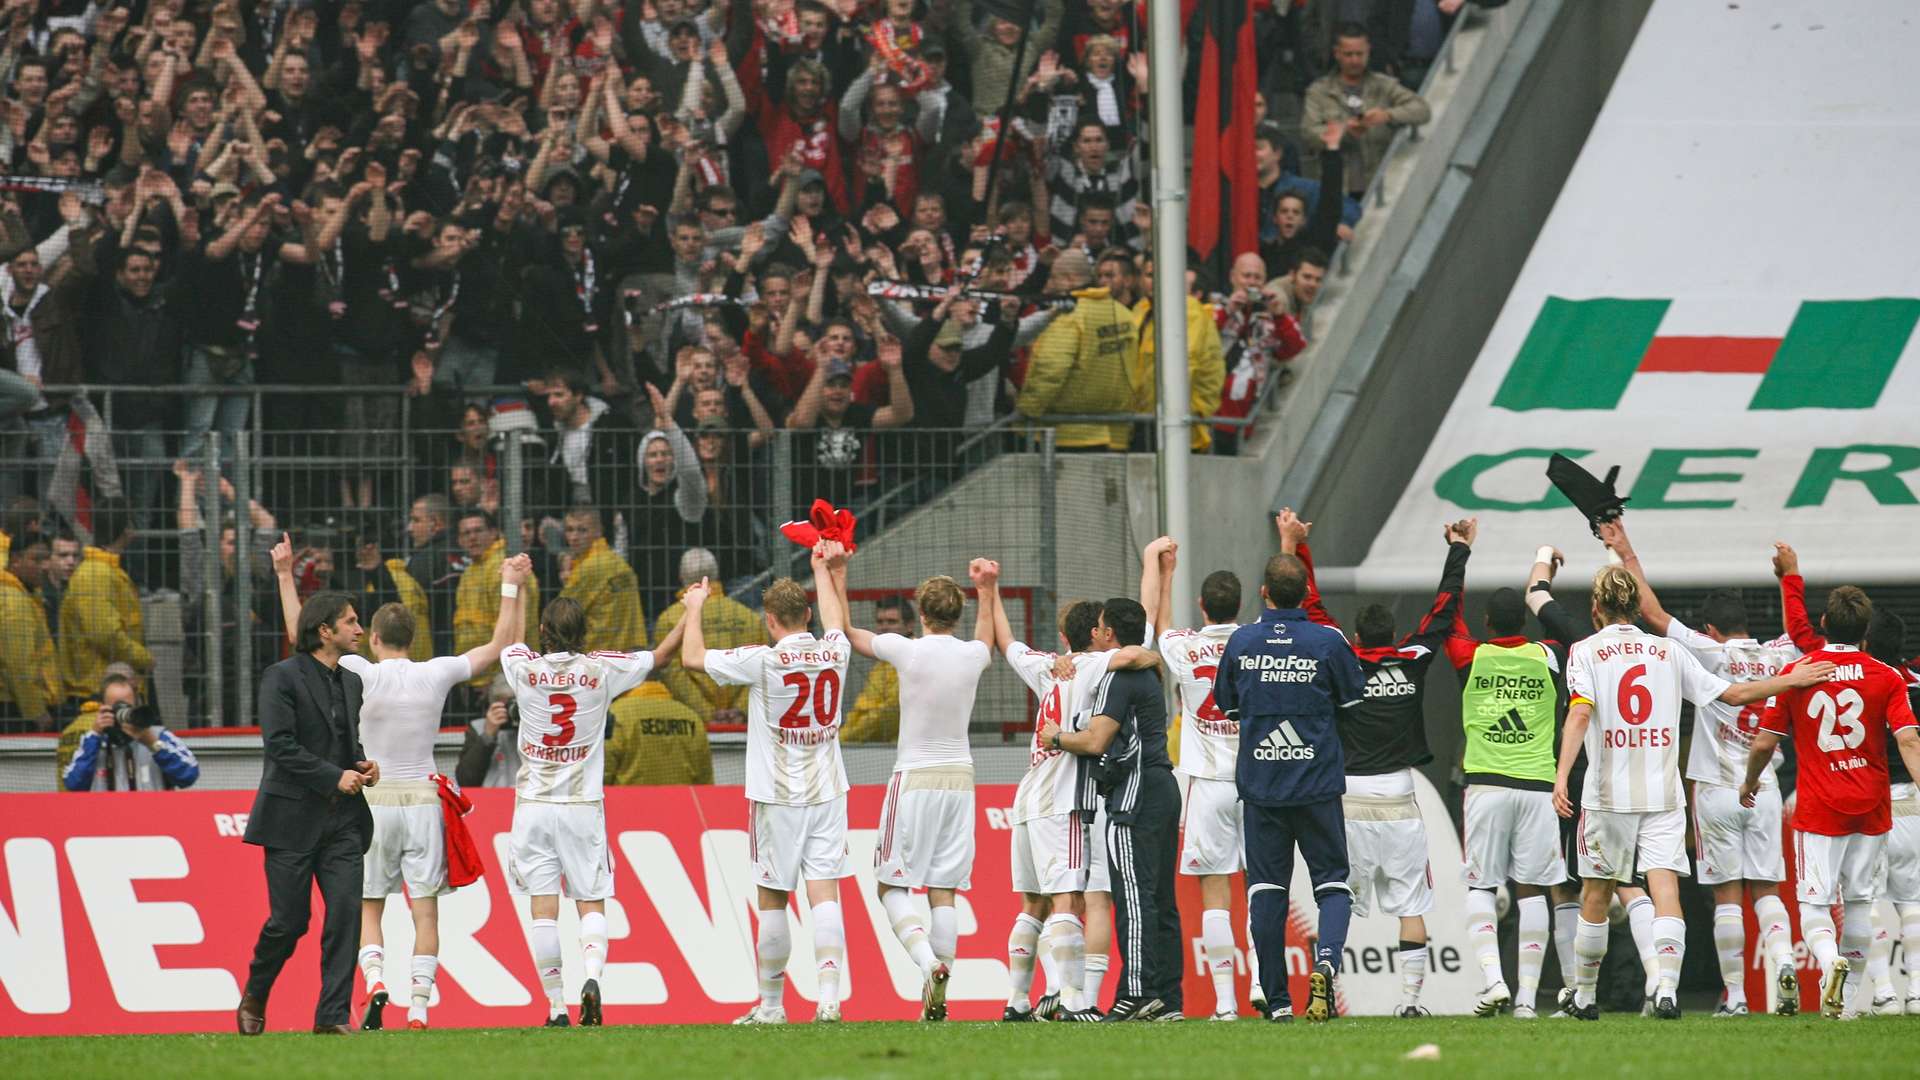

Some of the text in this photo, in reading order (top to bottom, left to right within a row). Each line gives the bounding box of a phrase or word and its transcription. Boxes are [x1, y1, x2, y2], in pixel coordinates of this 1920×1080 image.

[1434, 445, 1920, 512] GER
[1597, 642, 1667, 662] BAYER 04
[1239, 655, 1318, 671] TelDaFax
[1729, 662, 1766, 676] BAYER
[528, 672, 599, 690] BAYER 04
[1260, 671, 1317, 683] ENERGY
[1474, 675, 1546, 690] TelDaFax
[779, 668, 840, 729] 20
[1363, 681, 1416, 698] adidas
[1496, 689, 1545, 701] ENERGY
[1617, 664, 1652, 726] 6
[542, 693, 577, 747] 3
[640, 719, 696, 737] SECURITY
[1807, 687, 1866, 753] 23
[1482, 730, 1536, 744] adidas
[1604, 727, 1672, 749] ROLFES
[1254, 744, 1315, 761] adidas
